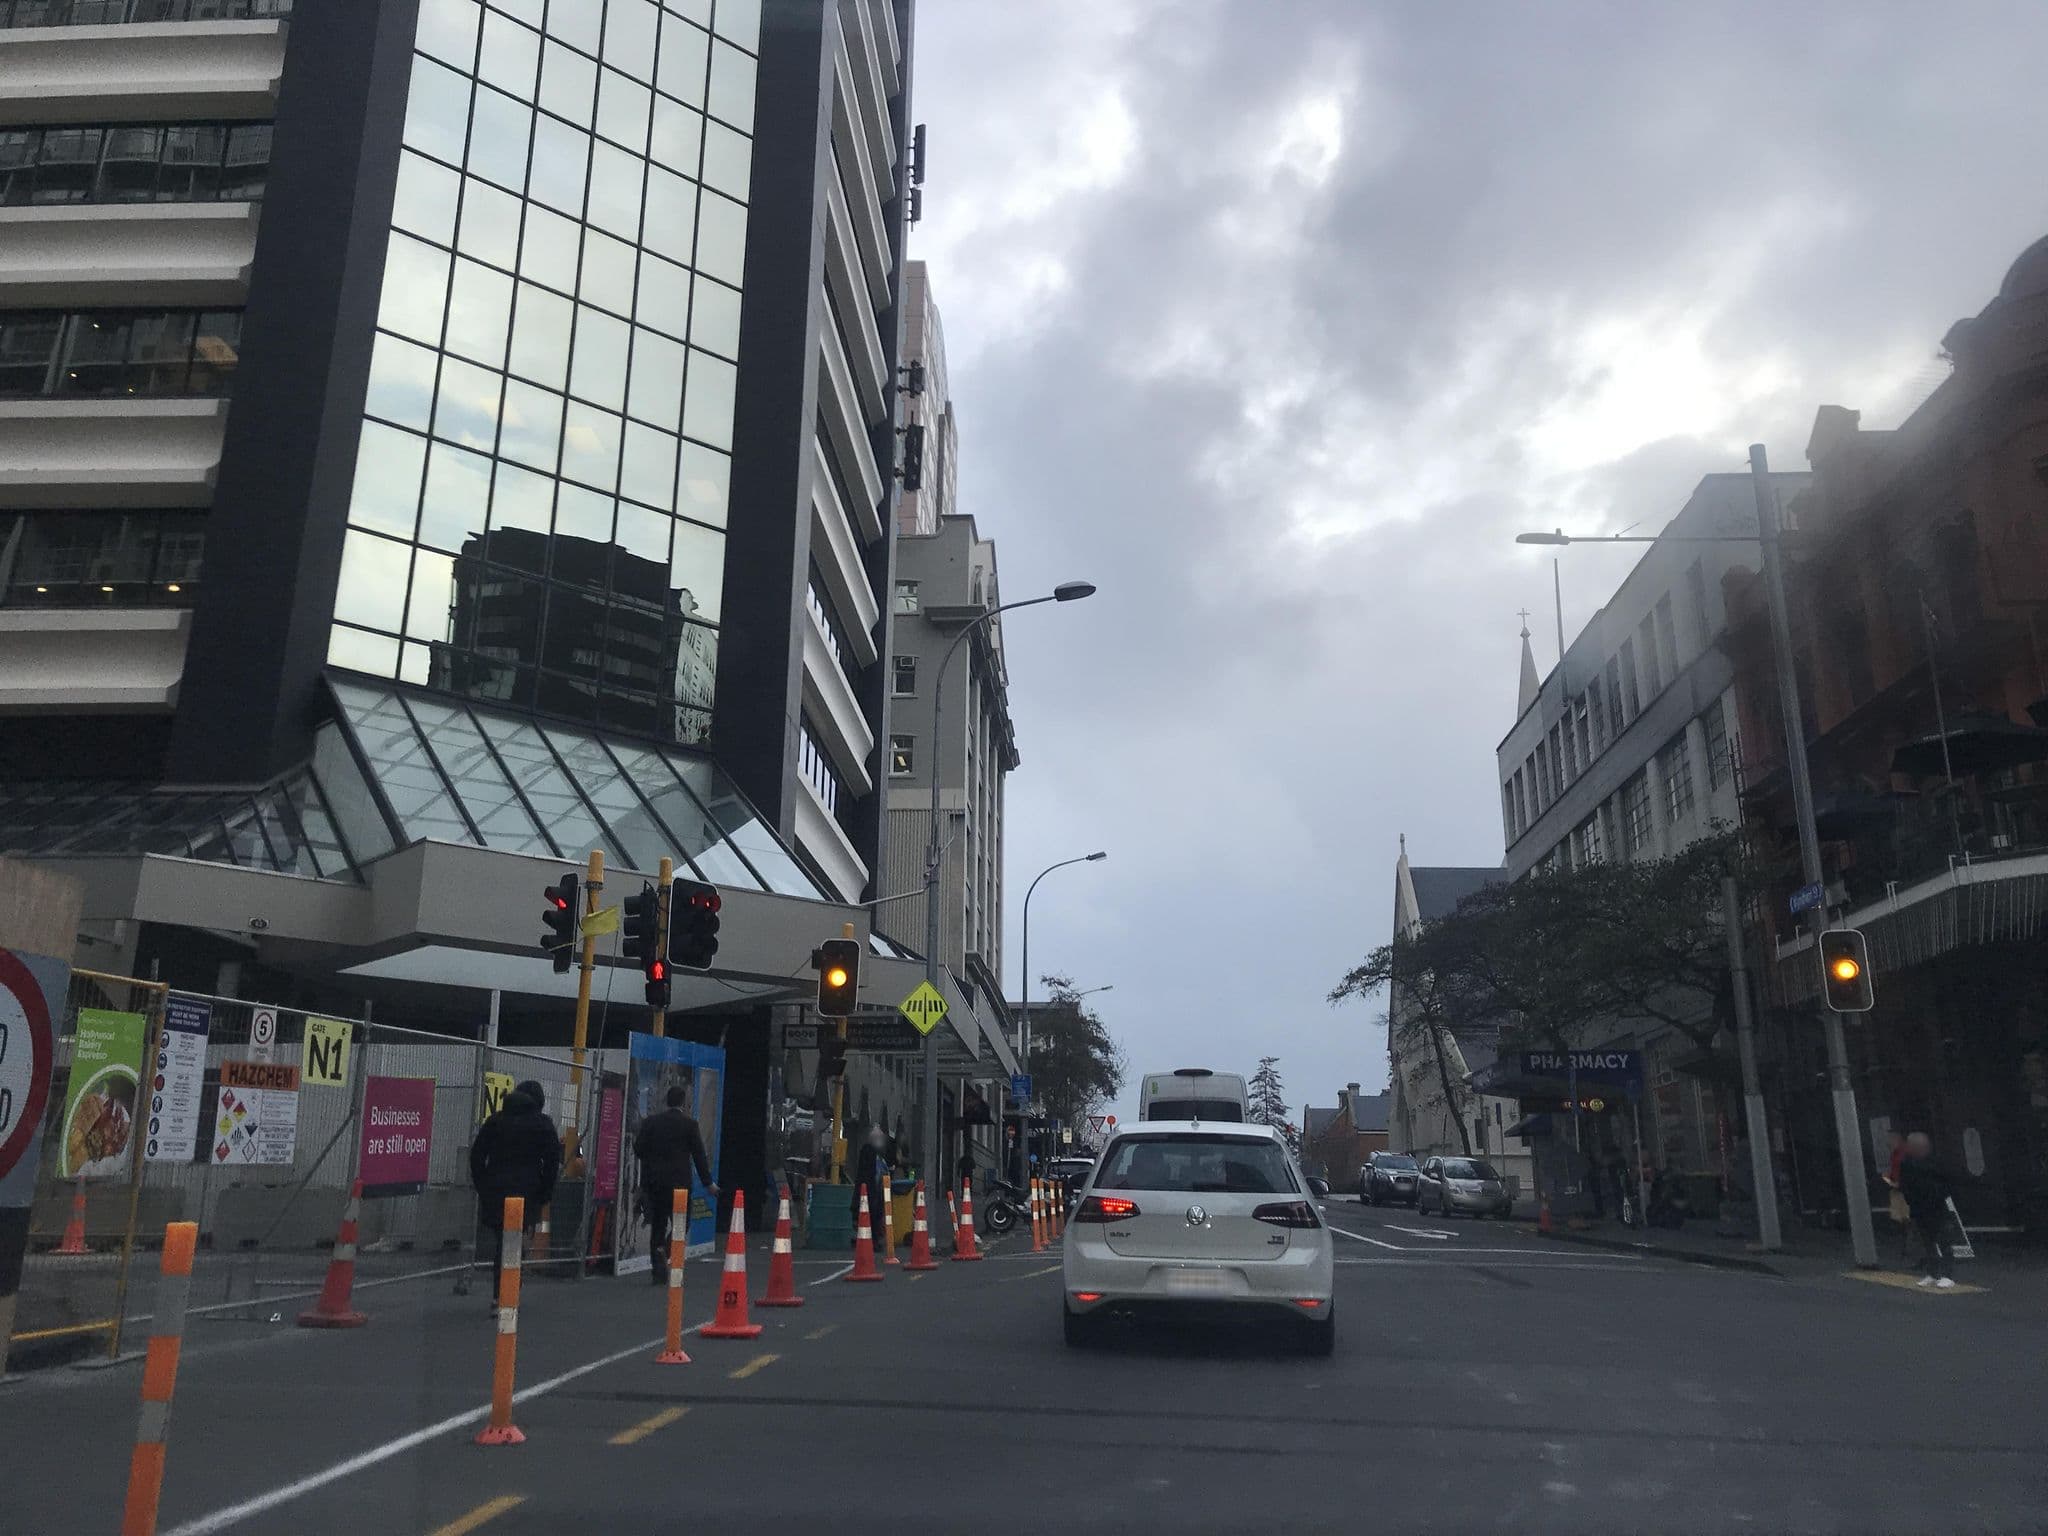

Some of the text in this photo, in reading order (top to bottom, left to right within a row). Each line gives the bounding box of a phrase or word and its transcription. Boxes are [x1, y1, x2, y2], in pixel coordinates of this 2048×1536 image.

[260, 1021, 267, 1036] 5
[312, 1023, 327, 1033] GATE
[308, 1034, 343, 1080] N1
[1530, 1055, 1628, 1069] PHARMACY
[229, 1063, 293, 1088] HAZCHEM
[371, 1106, 420, 1126] Businesses
[368, 1134, 426, 1157] are still open
